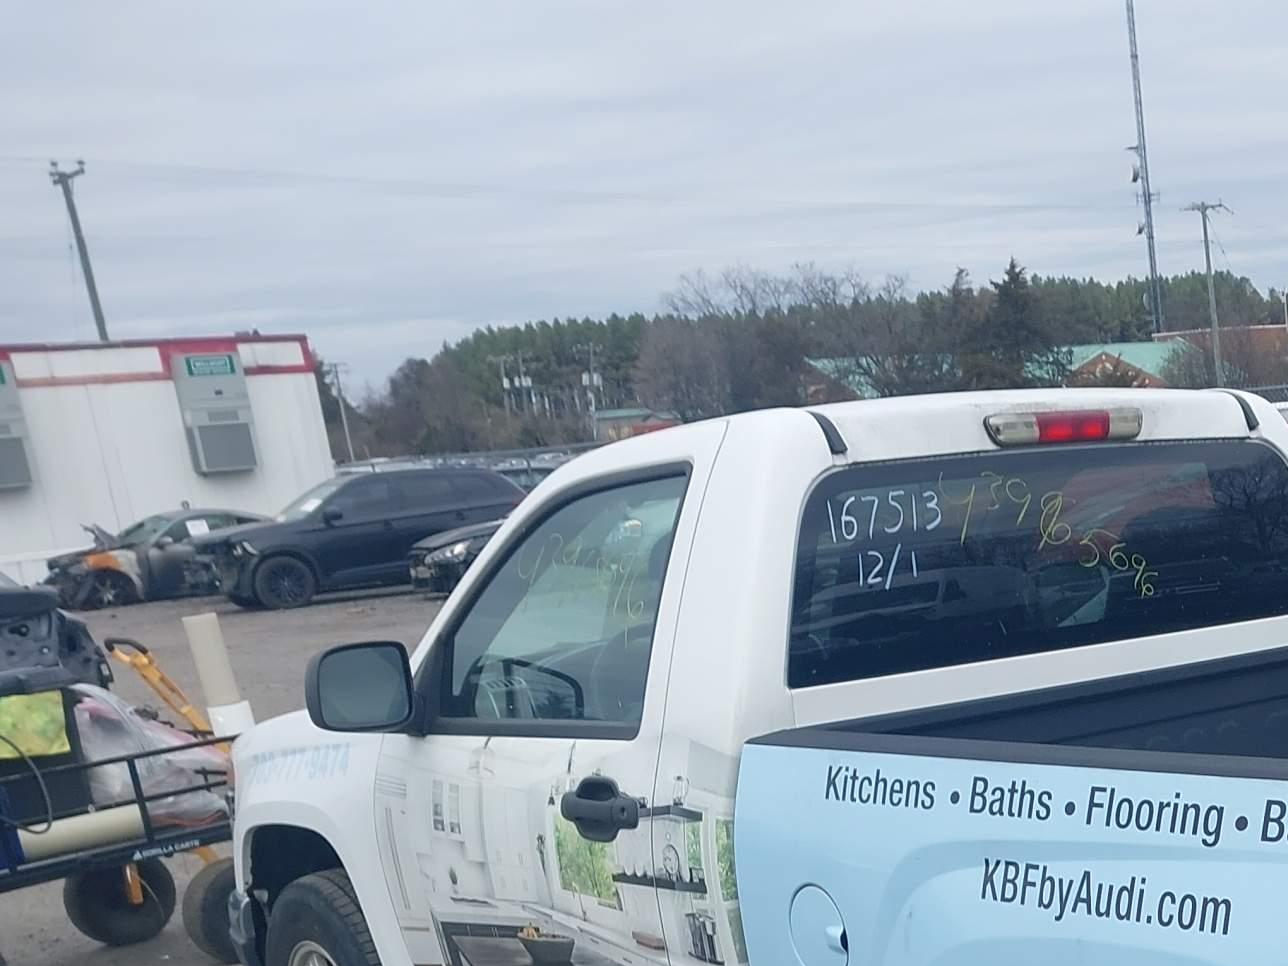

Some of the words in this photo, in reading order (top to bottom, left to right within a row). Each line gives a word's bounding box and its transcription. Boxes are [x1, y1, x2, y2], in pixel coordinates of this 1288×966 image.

[827, 490, 942, 544] 167513
[858, 544, 919, 590] 12/1
[825, 765, 936, 810] Kitchens
[969, 776, 1053, 820] Baths
[1085, 786, 1224, 847] Flooring
[981, 858, 1232, 935] KBFbyAudi.com
